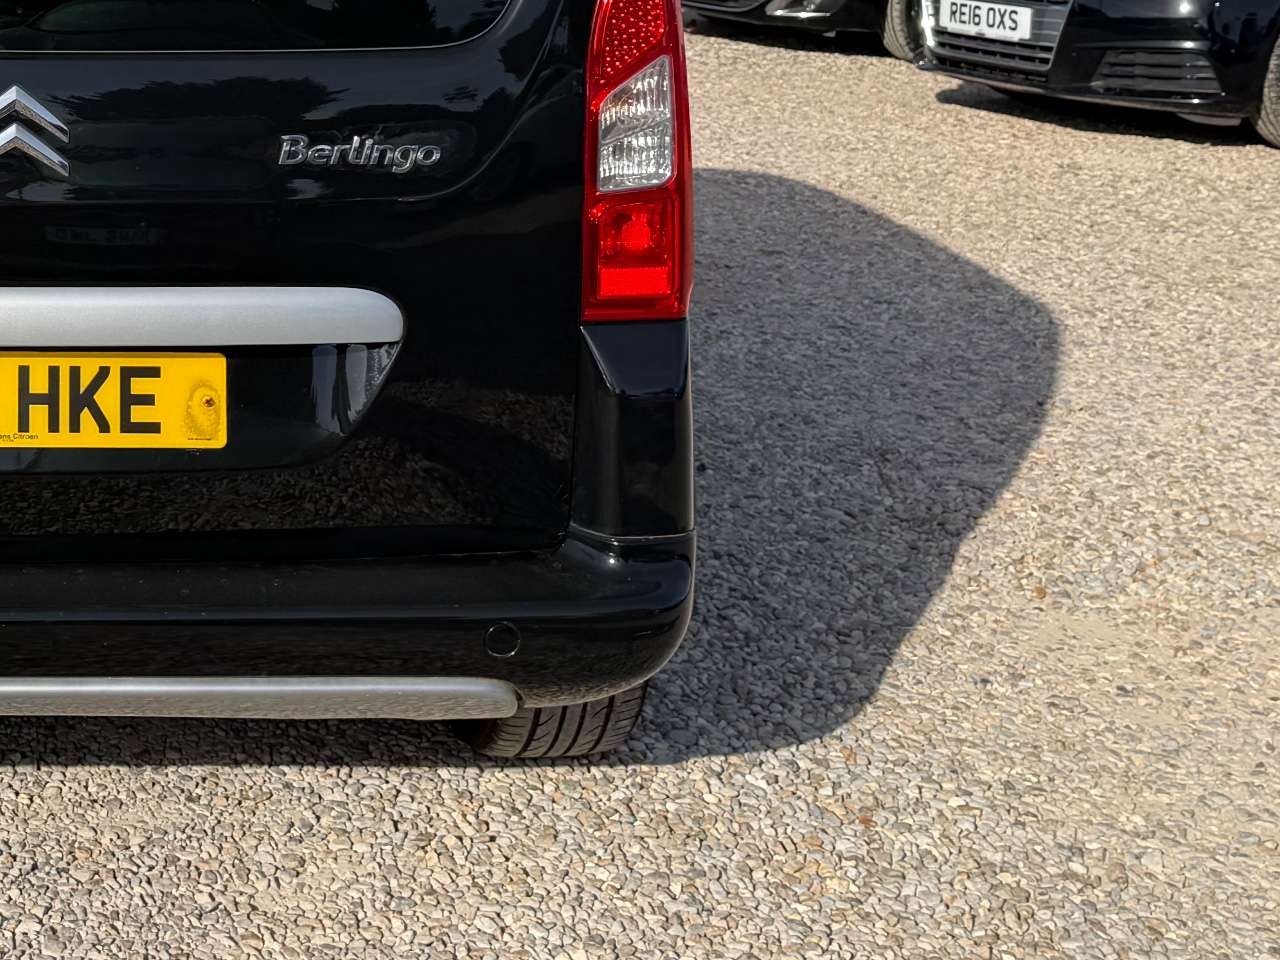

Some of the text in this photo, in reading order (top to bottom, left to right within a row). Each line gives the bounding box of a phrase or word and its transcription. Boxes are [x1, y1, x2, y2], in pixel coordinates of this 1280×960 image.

[949, 1, 1019, 31] RE16 OXS
[278, 134, 441, 173] Berlingo
[18, 365, 161, 434] HKE
